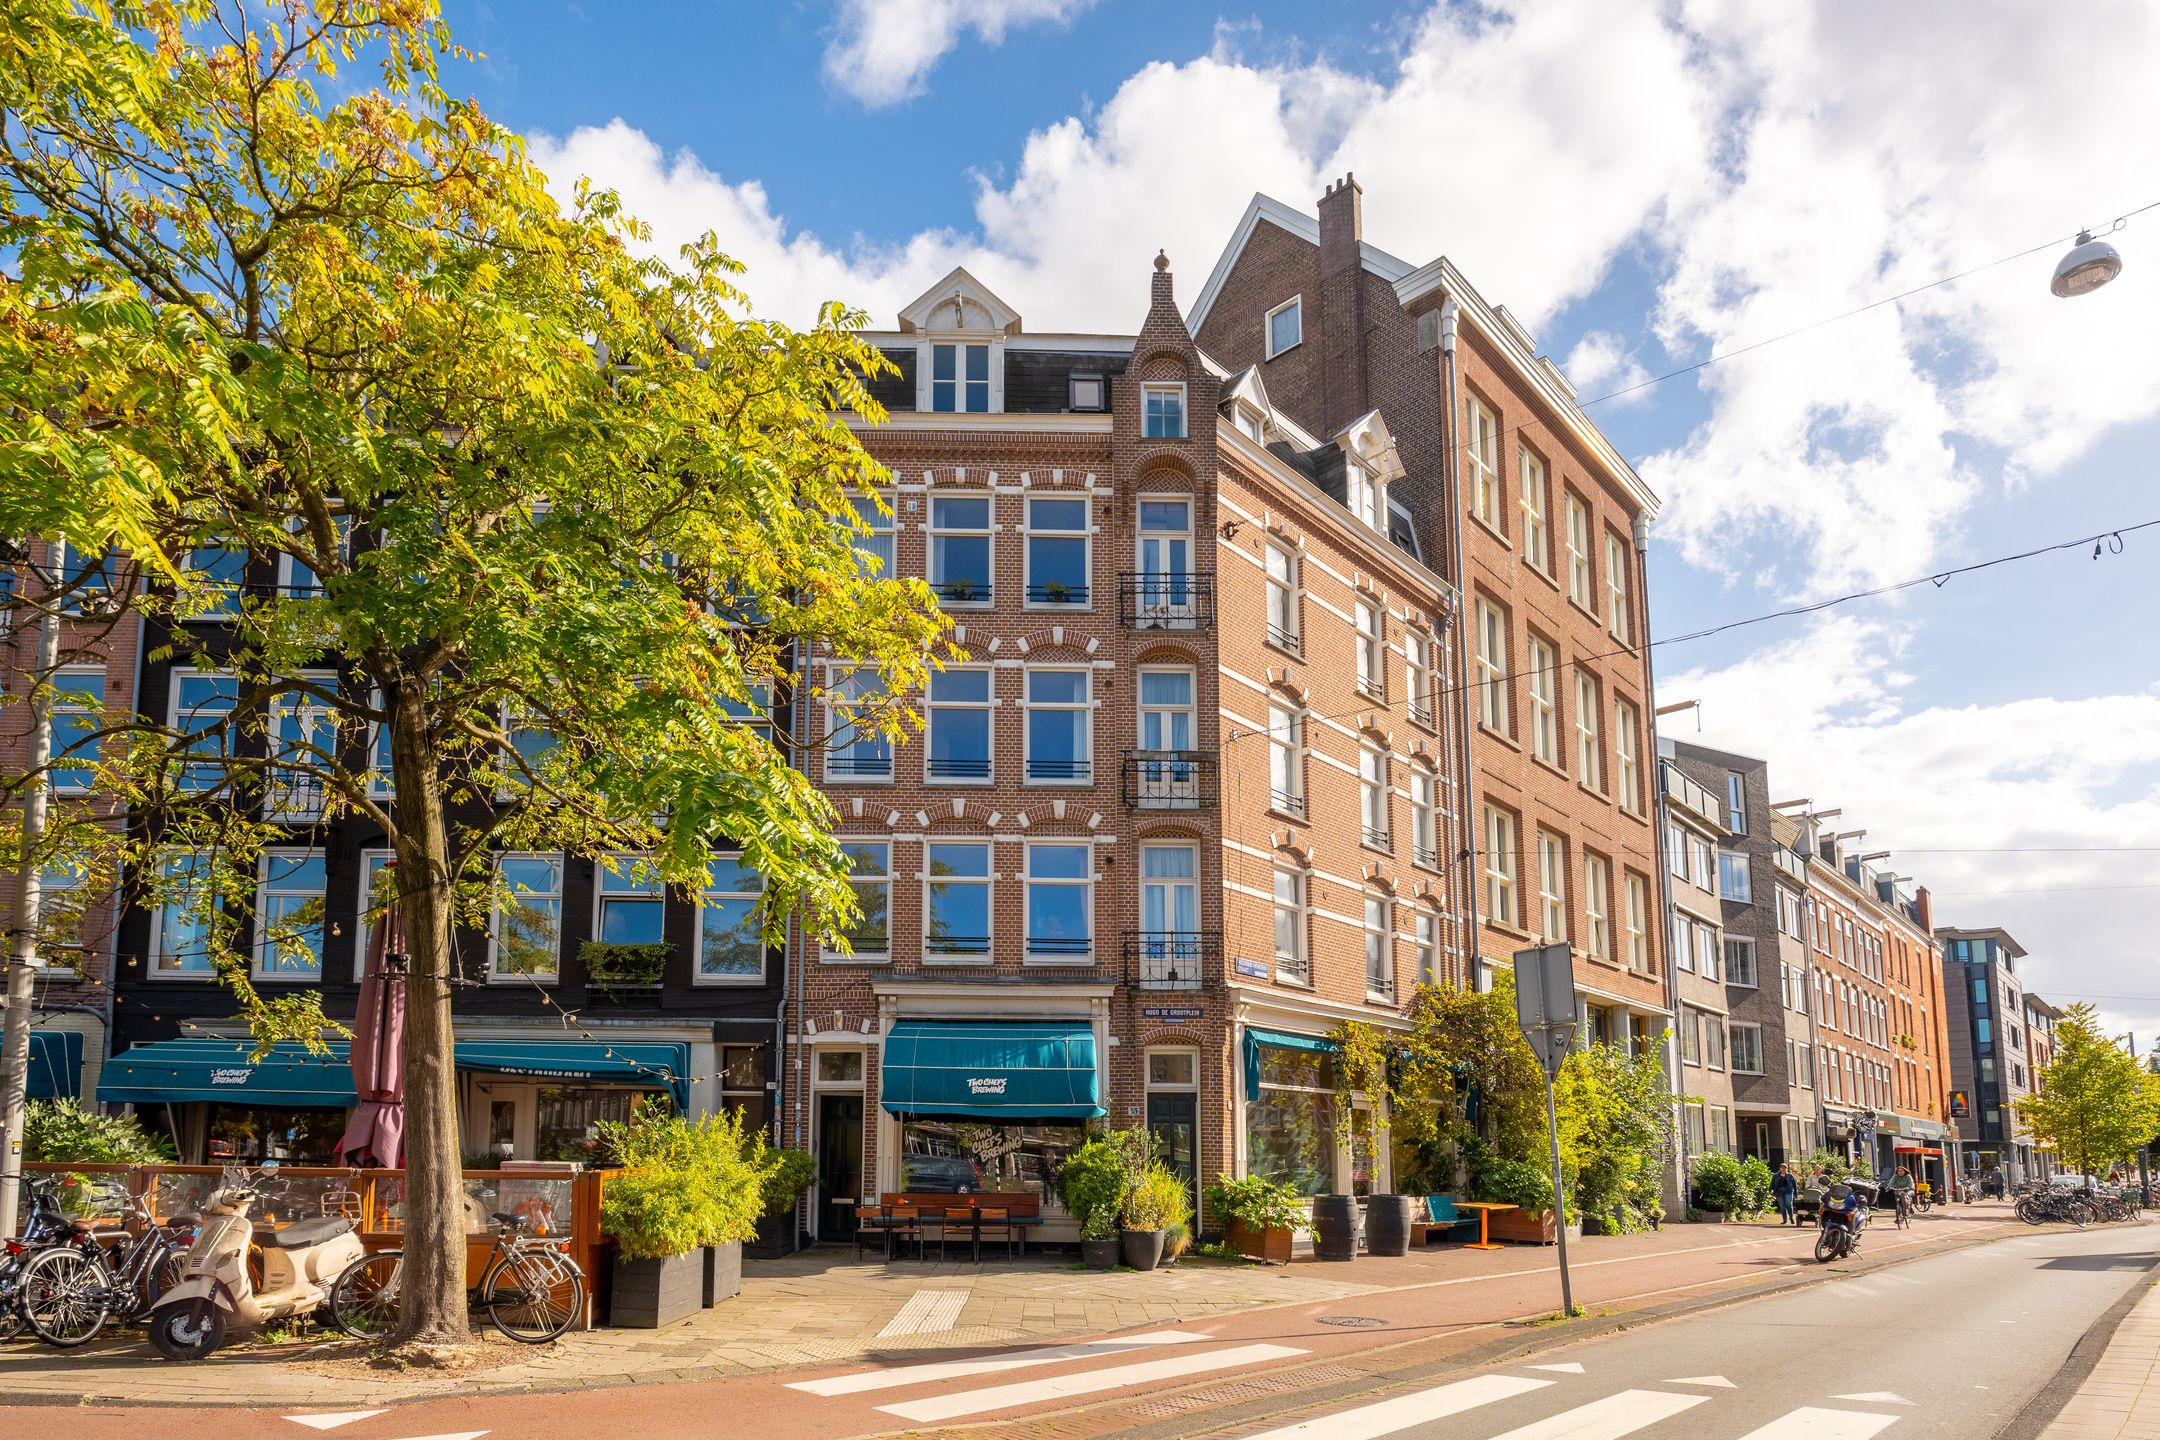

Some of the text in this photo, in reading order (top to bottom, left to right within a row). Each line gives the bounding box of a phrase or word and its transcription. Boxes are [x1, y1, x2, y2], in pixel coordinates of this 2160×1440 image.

[966, 1078, 1008, 1087] TWO CHEFS
[971, 1085, 1005, 1094] BREWING
[972, 1128, 993, 1141] TWO
[972, 1132, 1003, 1153] CHEFS
[979, 1135, 1023, 1162] BREWING
